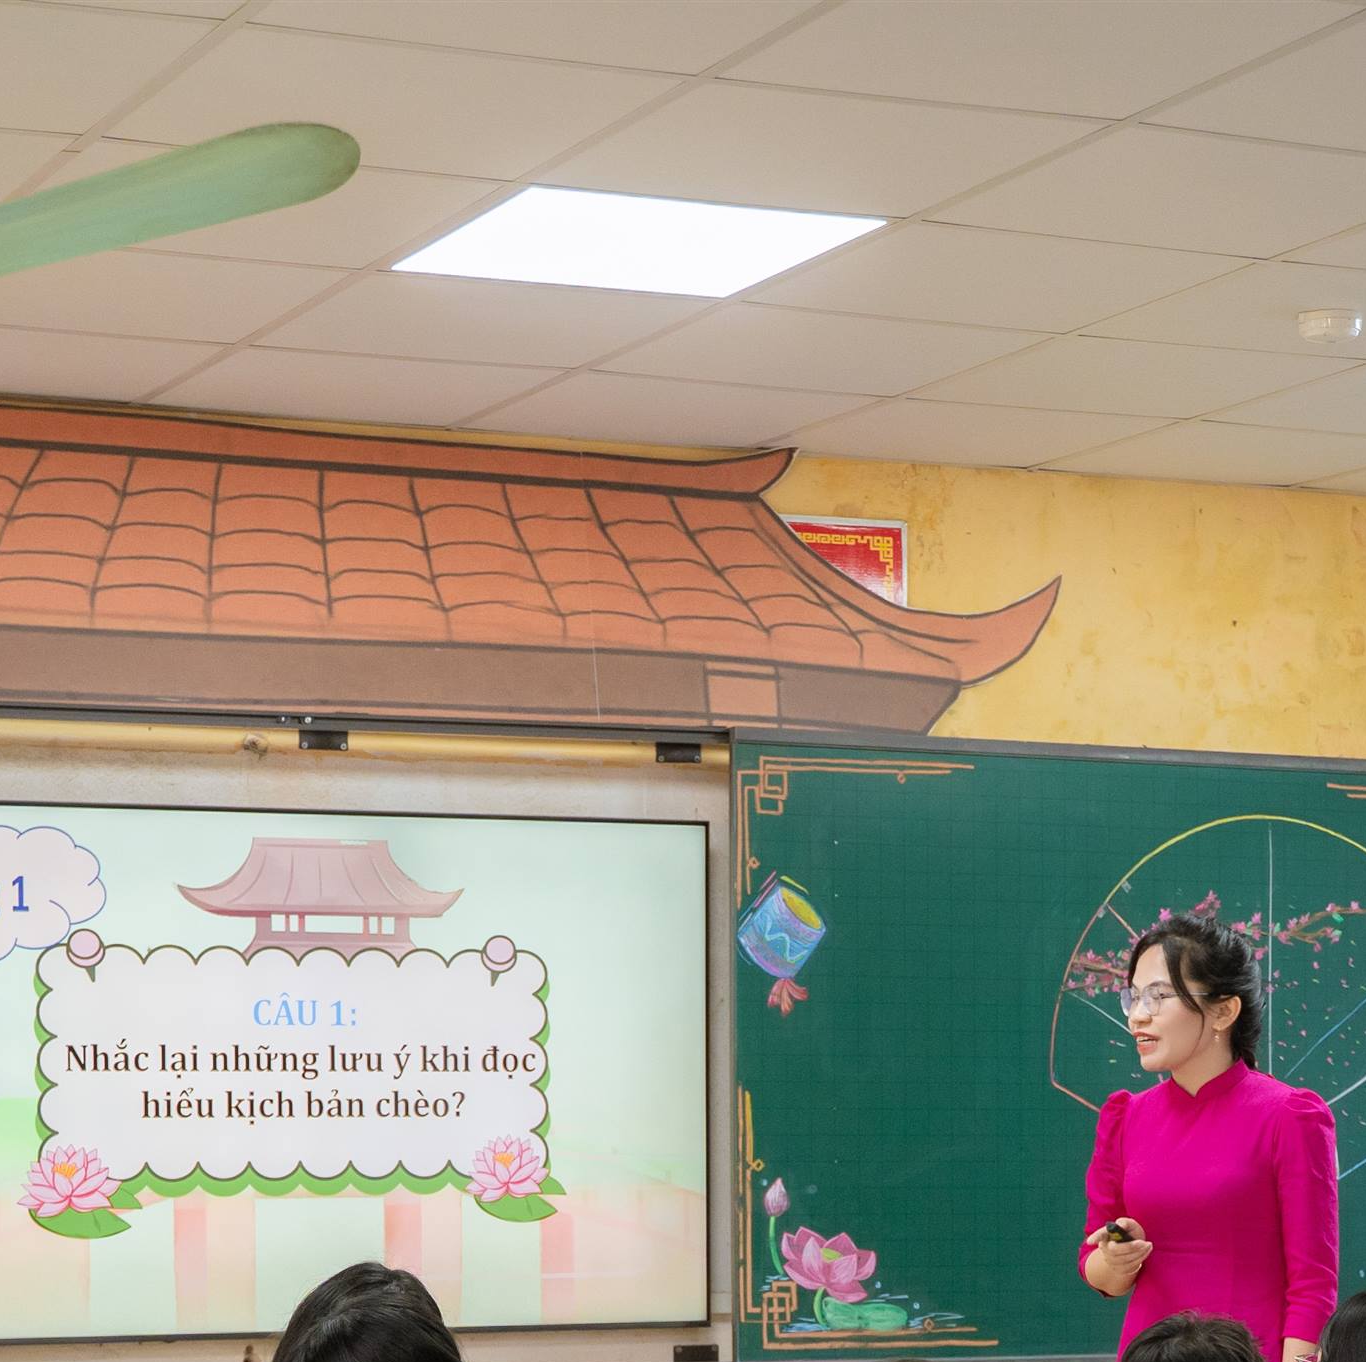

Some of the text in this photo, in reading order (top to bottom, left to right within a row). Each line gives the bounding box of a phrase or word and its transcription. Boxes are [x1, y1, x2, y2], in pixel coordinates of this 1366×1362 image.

[12, 875, 30, 912] 1
[253, 992, 357, 1027] CÂU 1:
[65, 1038, 537, 1081] Nhắc lại những lưu ý khi đọc
[141, 1087, 466, 1126] hiểu kịch bản chèo?
